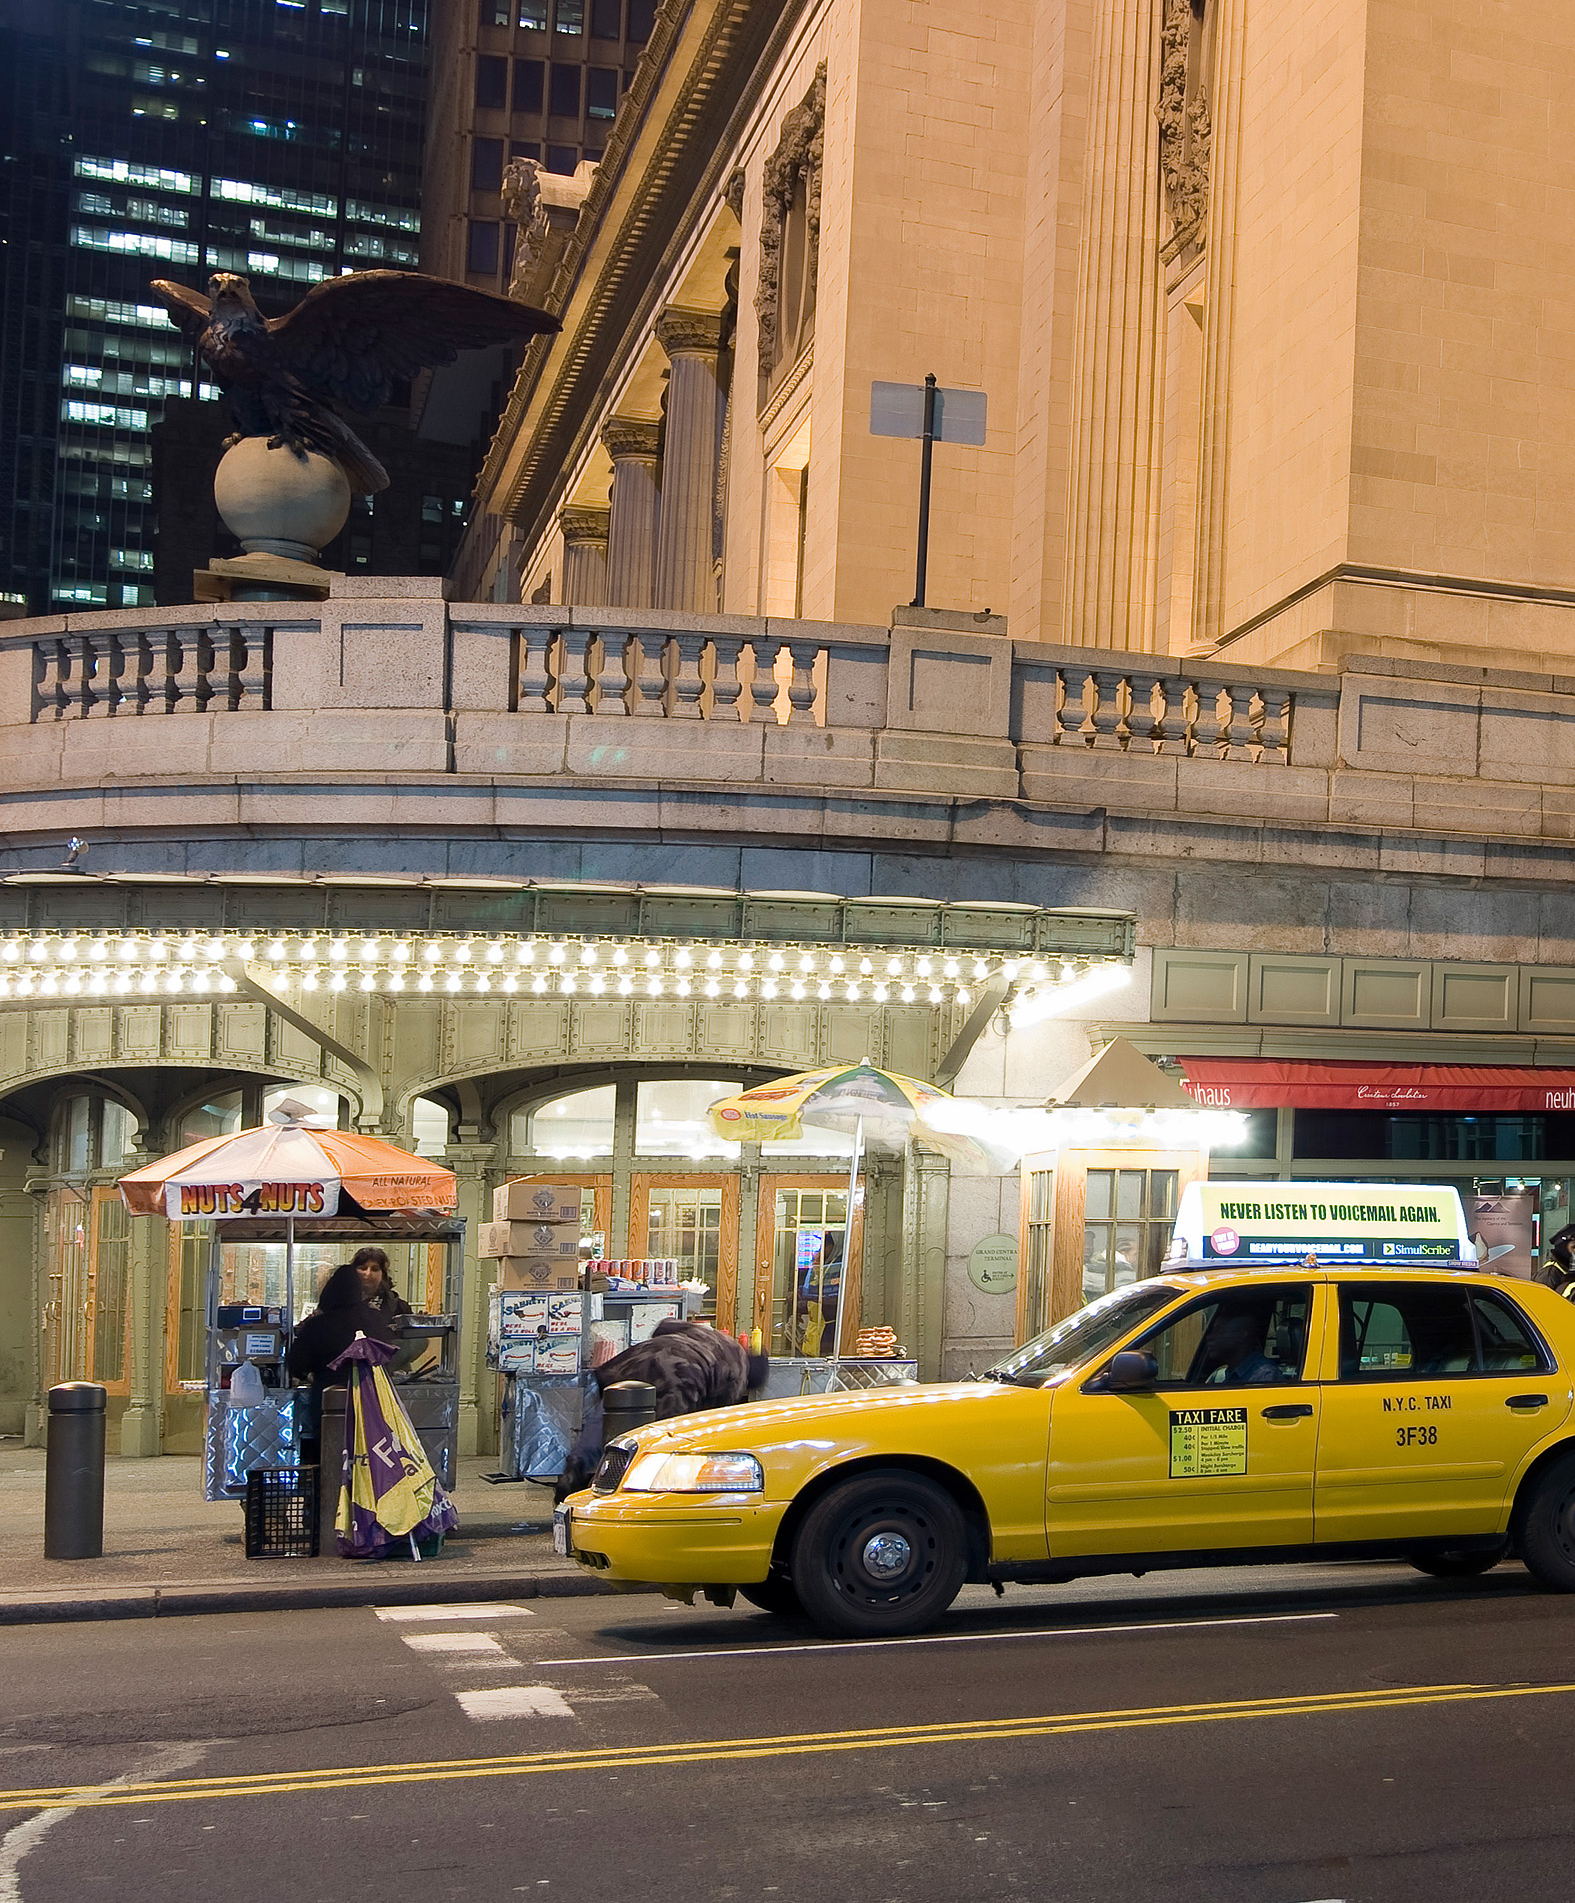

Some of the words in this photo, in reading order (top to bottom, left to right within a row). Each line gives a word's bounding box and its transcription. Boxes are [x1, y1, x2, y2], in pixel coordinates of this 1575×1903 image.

[372, 1178, 388, 1187] ALL
[390, 1176, 431, 1187] NATURAL
[1220, 1202, 1262, 1220] NEVER
[1265, 1204, 1308, 1220] LISTEN
[1310, 1204, 1327, 1221] TO
[1330, 1205, 1397, 1222] VOICEMAIL
[1399, 1205, 1441, 1223] AGAIN.
[504, 1298, 546, 1316] SABRETT
[1383, 1397, 1420, 1411] N.Y.C.
[1424, 1395, 1451, 1409] TAXI
[1176, 1411, 1205, 1424] TAXI
[1210, 1409, 1242, 1423] FARE
[1173, 1426, 1193, 1434] $2.50
[1396, 1426, 1438, 1446] 3F38
